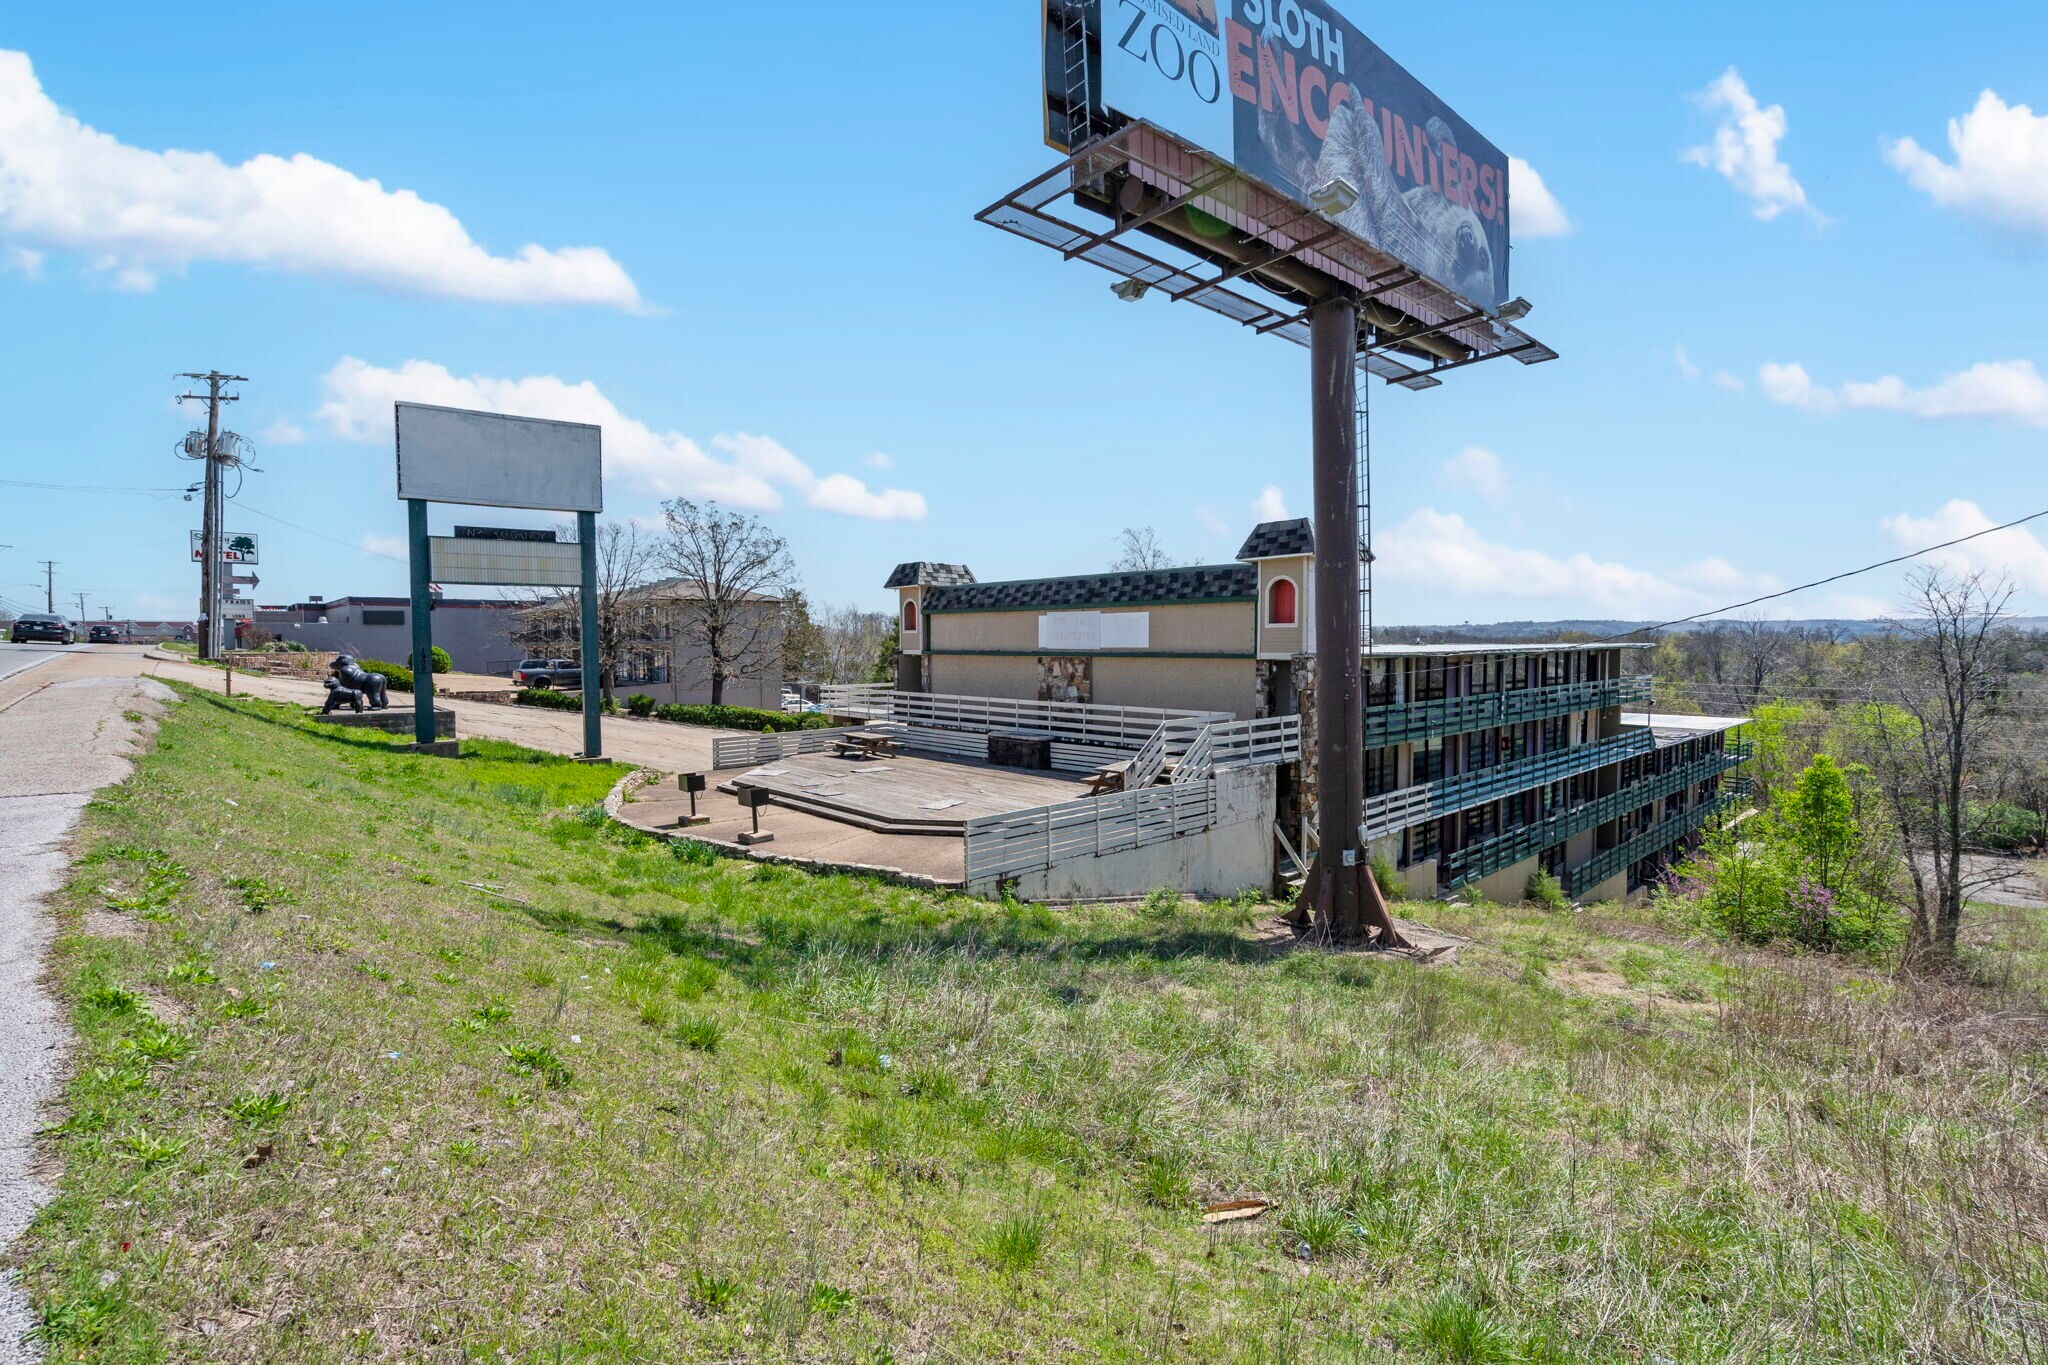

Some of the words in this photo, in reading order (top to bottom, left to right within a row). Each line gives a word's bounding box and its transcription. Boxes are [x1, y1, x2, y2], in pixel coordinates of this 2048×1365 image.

[1117, 0, 1220, 104] ZOO
[1139, 0, 1185, 33] MISED
[1188, 24, 1221, 57] LAND
